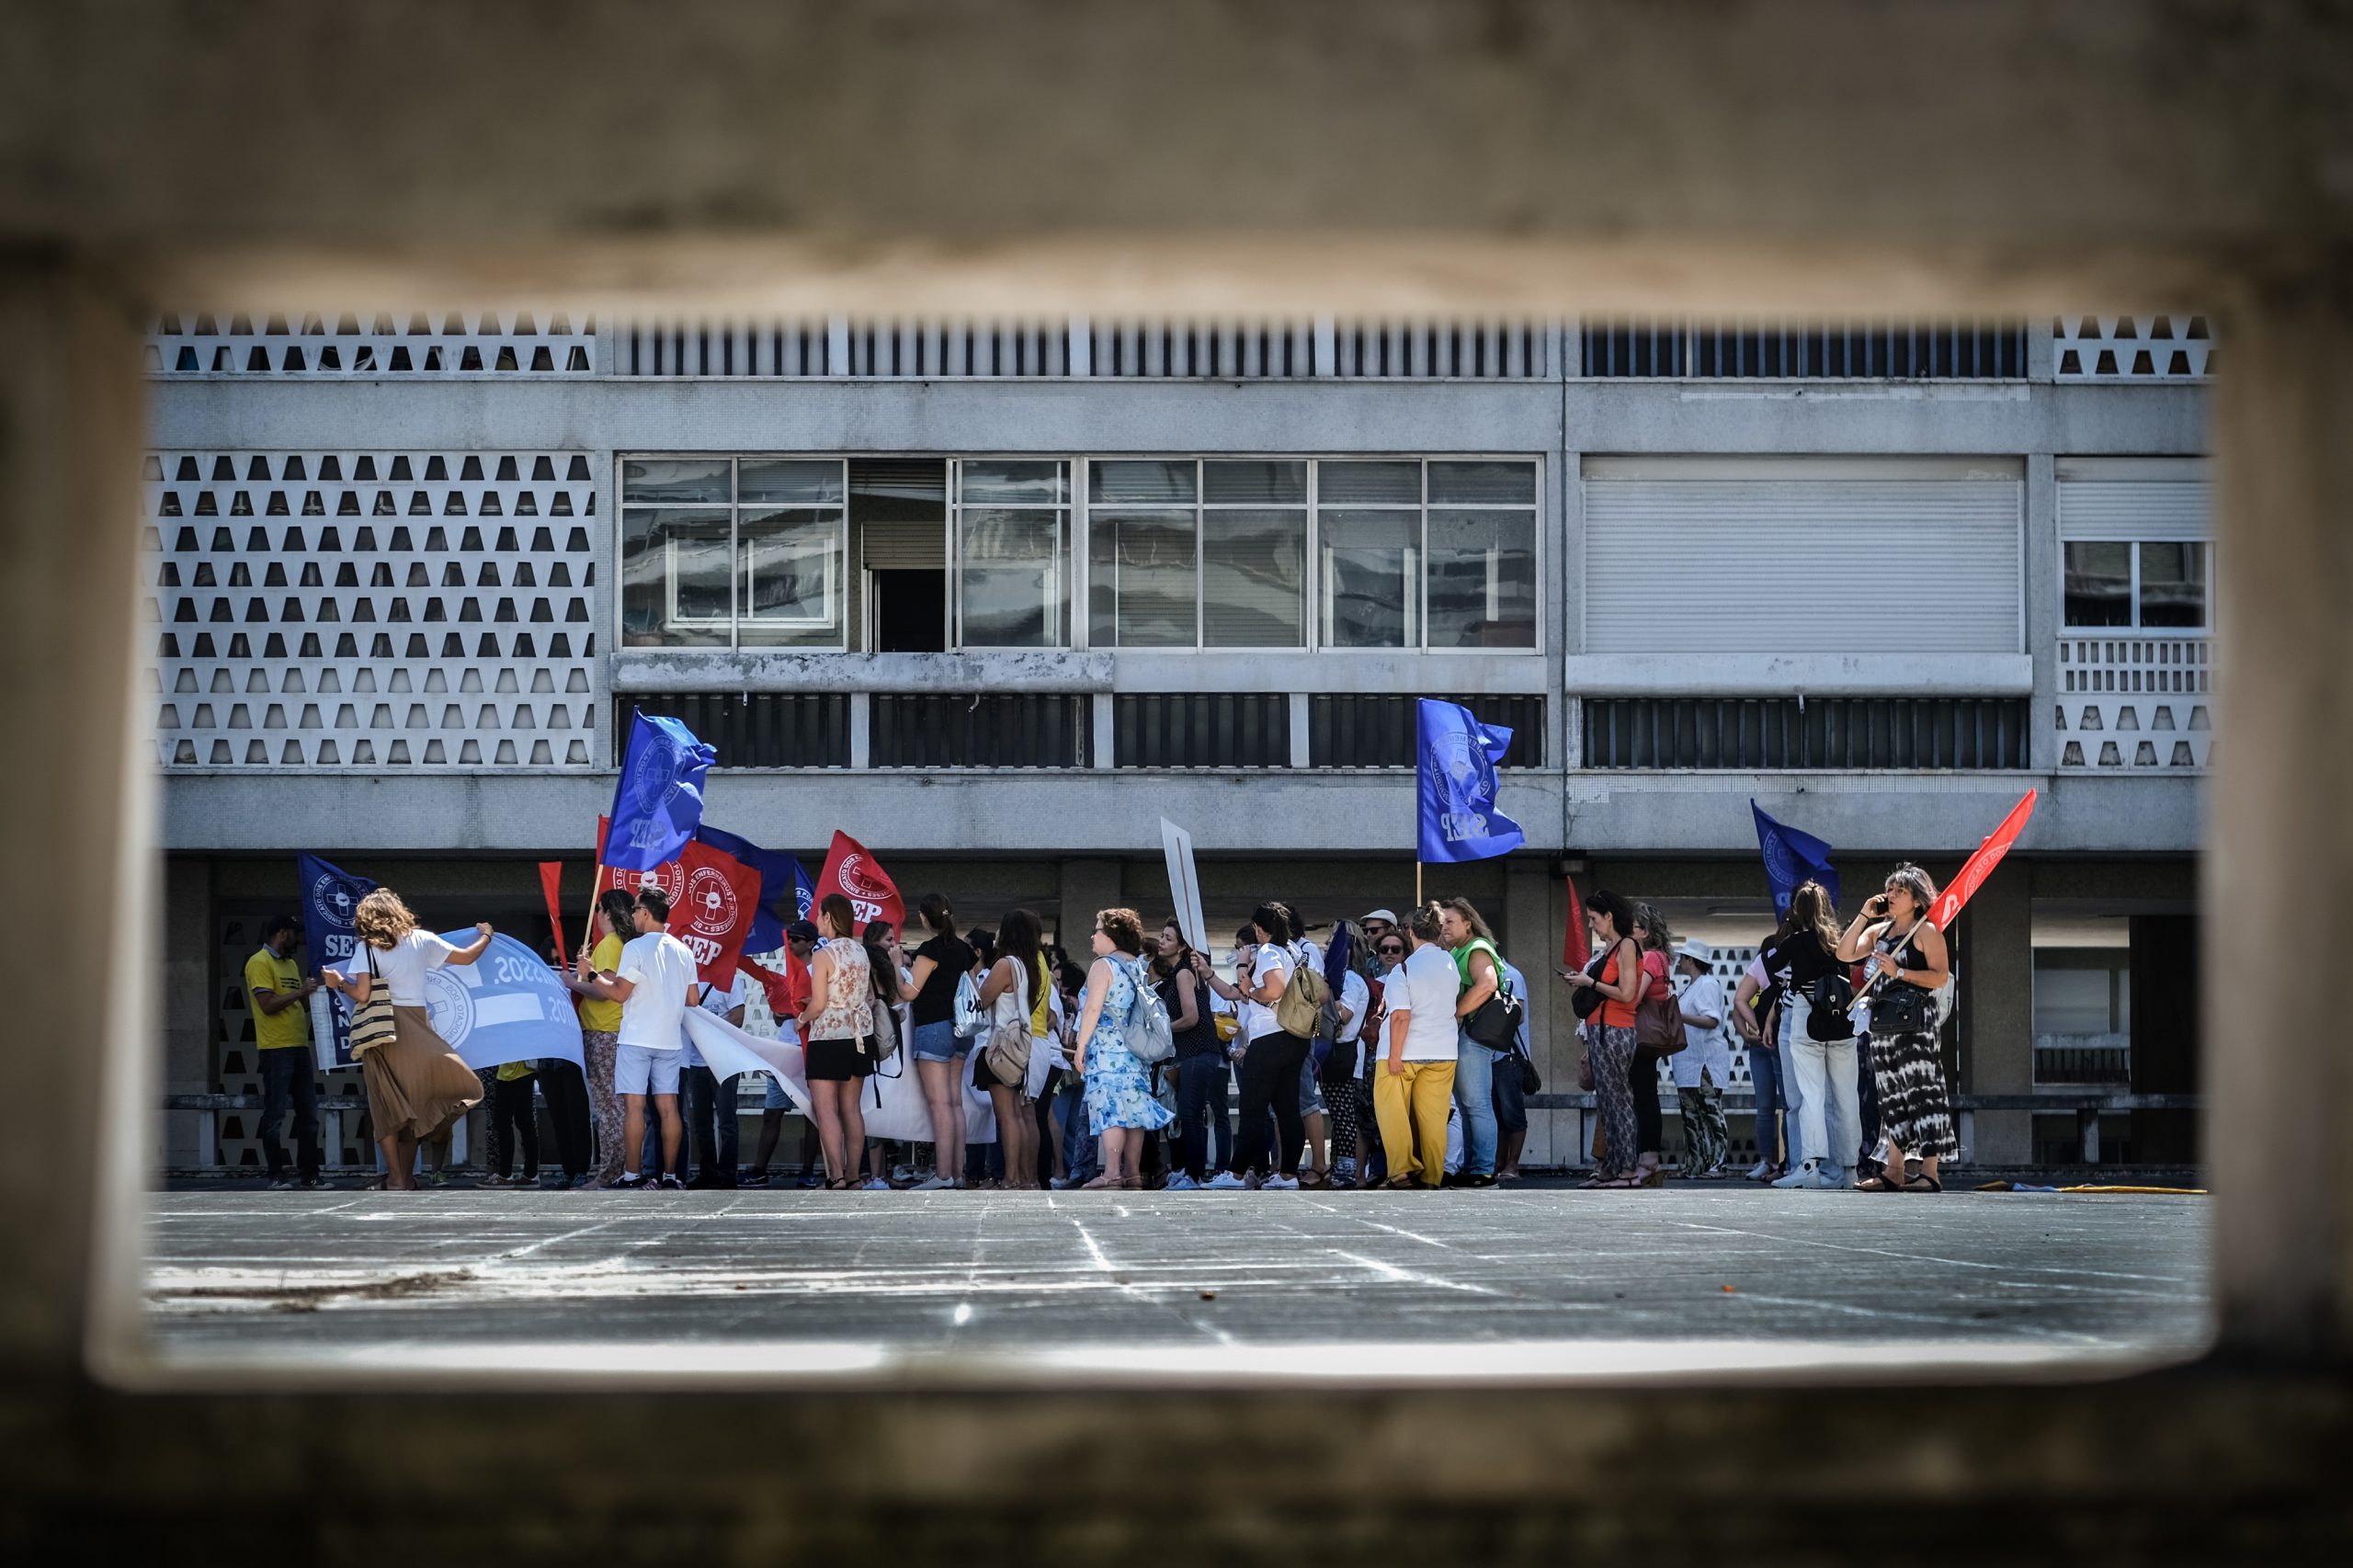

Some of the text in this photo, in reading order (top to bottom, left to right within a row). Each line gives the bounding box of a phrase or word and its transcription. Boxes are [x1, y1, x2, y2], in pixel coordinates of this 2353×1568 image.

[315, 884, 324, 897] DOS
[668, 864, 682, 903] PORTUGU
[316, 899, 342, 925] SINDICATO
[850, 899, 883, 924] EP
[324, 934, 358, 957] SE
